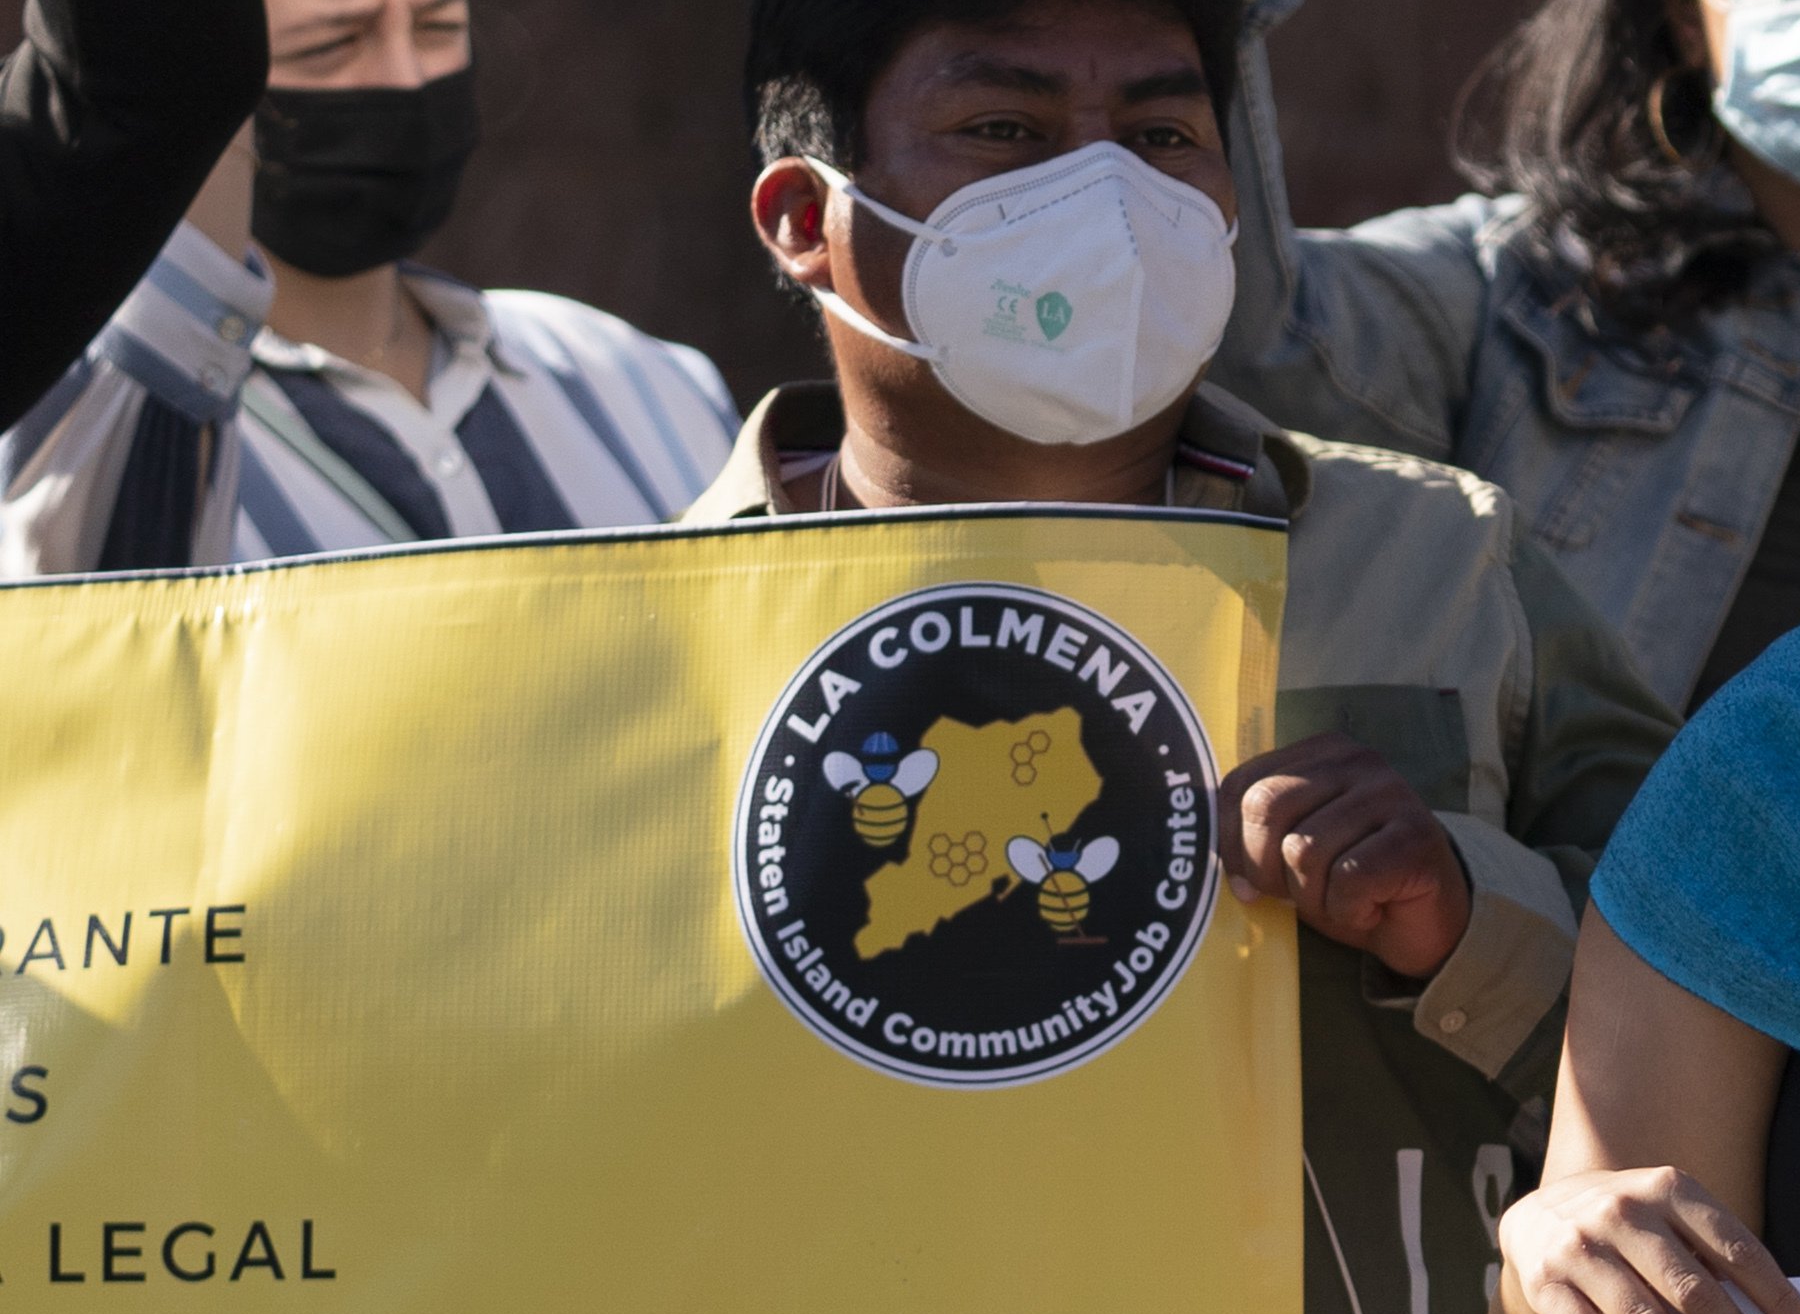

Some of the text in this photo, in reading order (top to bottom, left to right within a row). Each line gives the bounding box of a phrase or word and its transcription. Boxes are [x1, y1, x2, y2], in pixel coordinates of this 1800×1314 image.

[786, 668, 863, 744] LA
[868, 606, 1158, 735] COLMENA
[0, 905, 246, 977] ANTE
[757, 769, 1198, 1058] Staten Island Community Job Center
[50, 1218, 338, 1283] LEGAL
